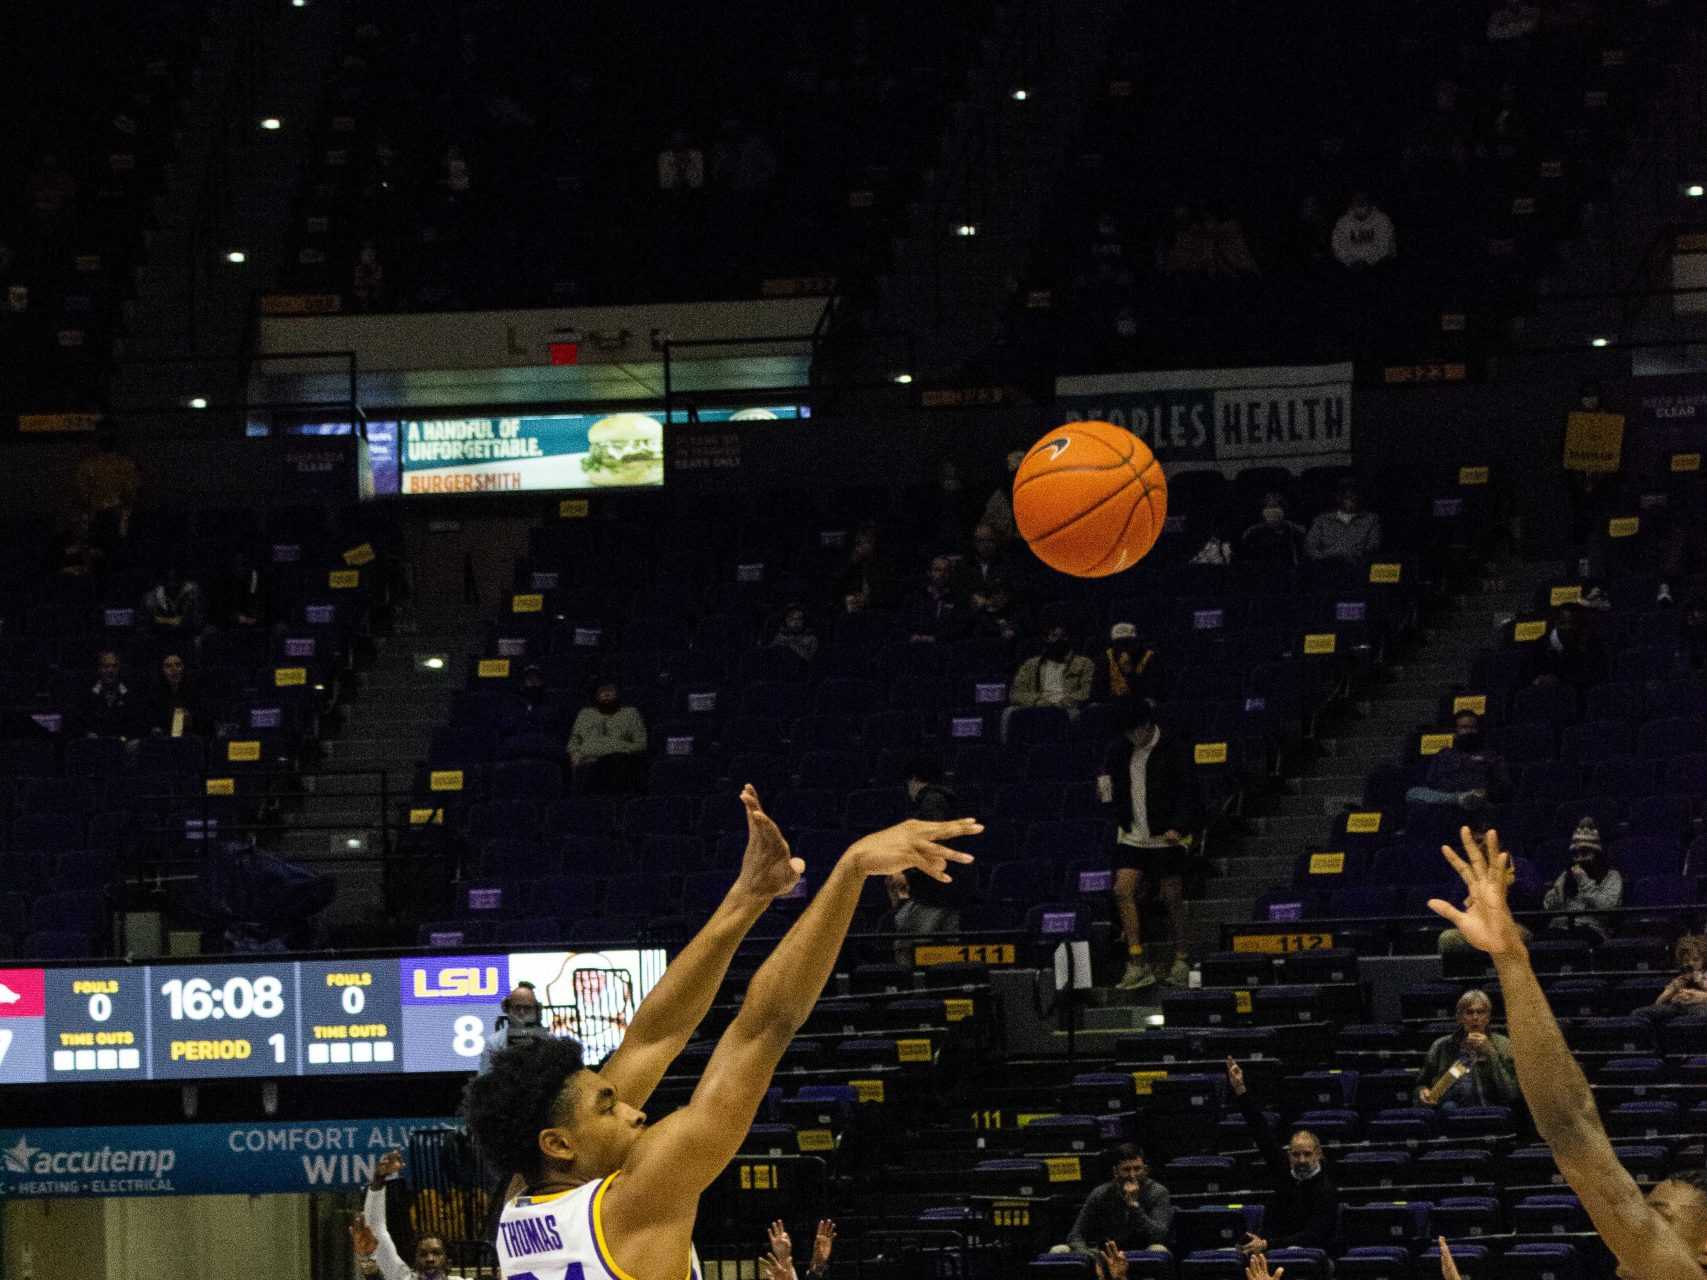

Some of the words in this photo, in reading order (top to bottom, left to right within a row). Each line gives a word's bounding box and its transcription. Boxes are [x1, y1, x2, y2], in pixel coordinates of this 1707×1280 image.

[408, 421, 420, 440] A
[423, 420, 494, 440] HANDFUL
[499, 419, 520, 438] OF
[1223, 397, 1343, 445] HEALTH
[408, 437, 543, 461] UNFORGETTABLE.
[411, 473, 521, 493] BURGERSMITH
[959, 945, 1003, 962] 111
[73, 980, 119, 994] FOULS
[327, 973, 372, 987] FOULS
[413, 967, 499, 998] LSU
[88, 993, 112, 1021] 0
[161, 976, 284, 1020] 16:08
[341, 986, 366, 1014] 0
[60, 1032, 94, 1046] TIME
[95, 1031, 134, 1045] OUTS
[313, 1026, 348, 1039] TIME
[349, 1024, 387, 1037] OUTS
[453, 1015, 485, 1057] 8
[170, 1040, 251, 1061] PERIOD
[268, 1033, 286, 1063] 1
[228, 1127, 358, 1152] COMFORT
[33, 1146, 175, 1178] accutemp
[302, 1153, 377, 1185] WIN
[19, 1181, 80, 1194] HEATING
[91, 1179, 175, 1192] ELECTRICAL
[500, 1215, 564, 1258] THOMAS
